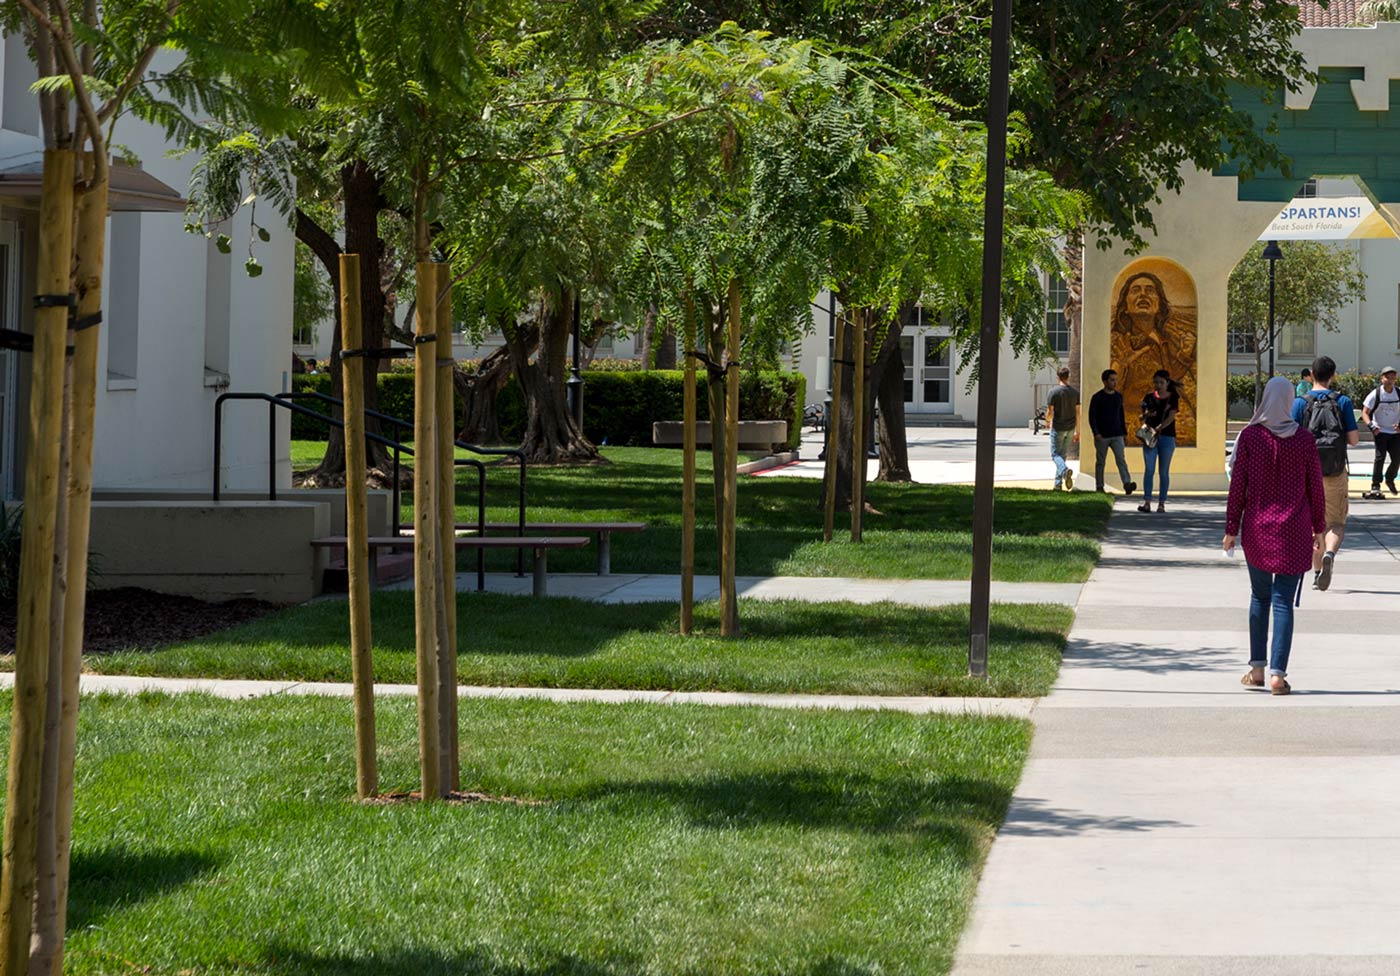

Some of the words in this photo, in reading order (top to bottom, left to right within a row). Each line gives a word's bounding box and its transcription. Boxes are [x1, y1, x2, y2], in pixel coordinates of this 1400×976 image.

[1280, 207, 1361, 220] SPARTANS!
[1271, 223, 1290, 231] Beat
[1291, 222, 1314, 231] South
[1315, 222, 1343, 230] Florida
